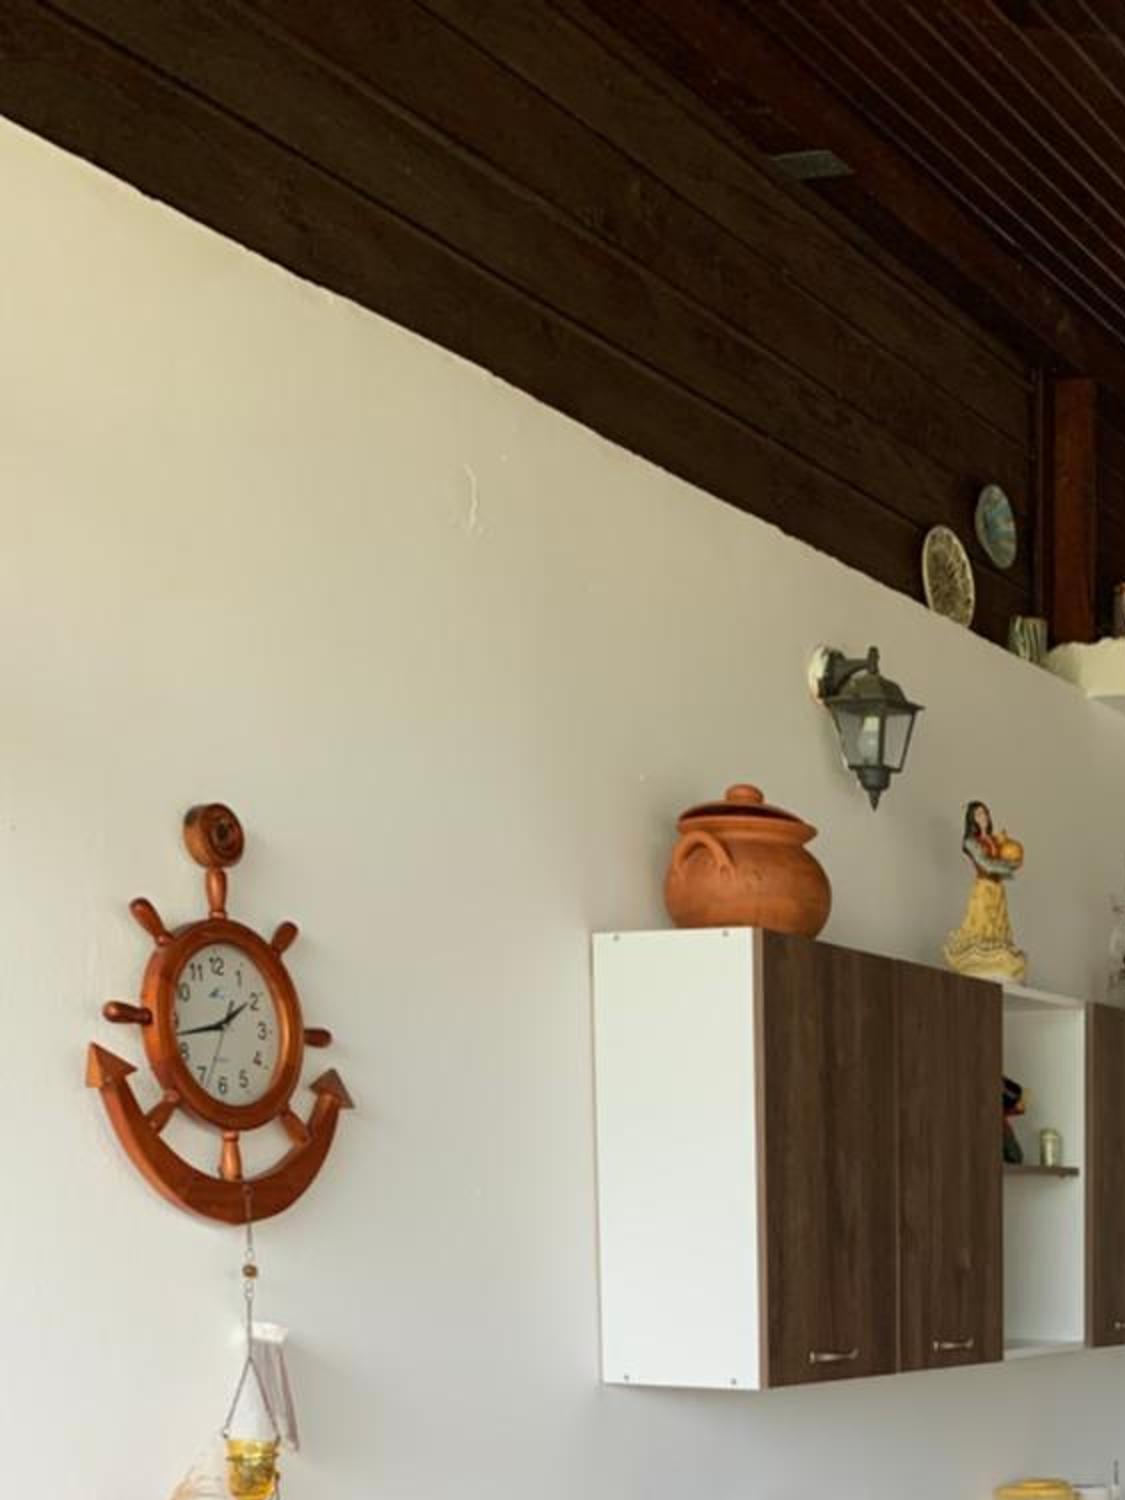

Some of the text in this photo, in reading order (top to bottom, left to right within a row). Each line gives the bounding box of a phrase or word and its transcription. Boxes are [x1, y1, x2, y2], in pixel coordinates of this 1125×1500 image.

[190, 962, 203, 982] 11
[209, 957, 224, 976] 12
[235, 970, 243, 987] 1
[178, 982, 190, 1001] 0
[250, 992, 260, 1011] 2
[257, 1021, 267, 1040] 3
[179, 1042, 189, 1061] 8
[252, 1051, 262, 1067] 4
[197, 1065, 207, 1082] 7
[238, 1069, 248, 1089] 5
[217, 1076, 228, 1095] 6
